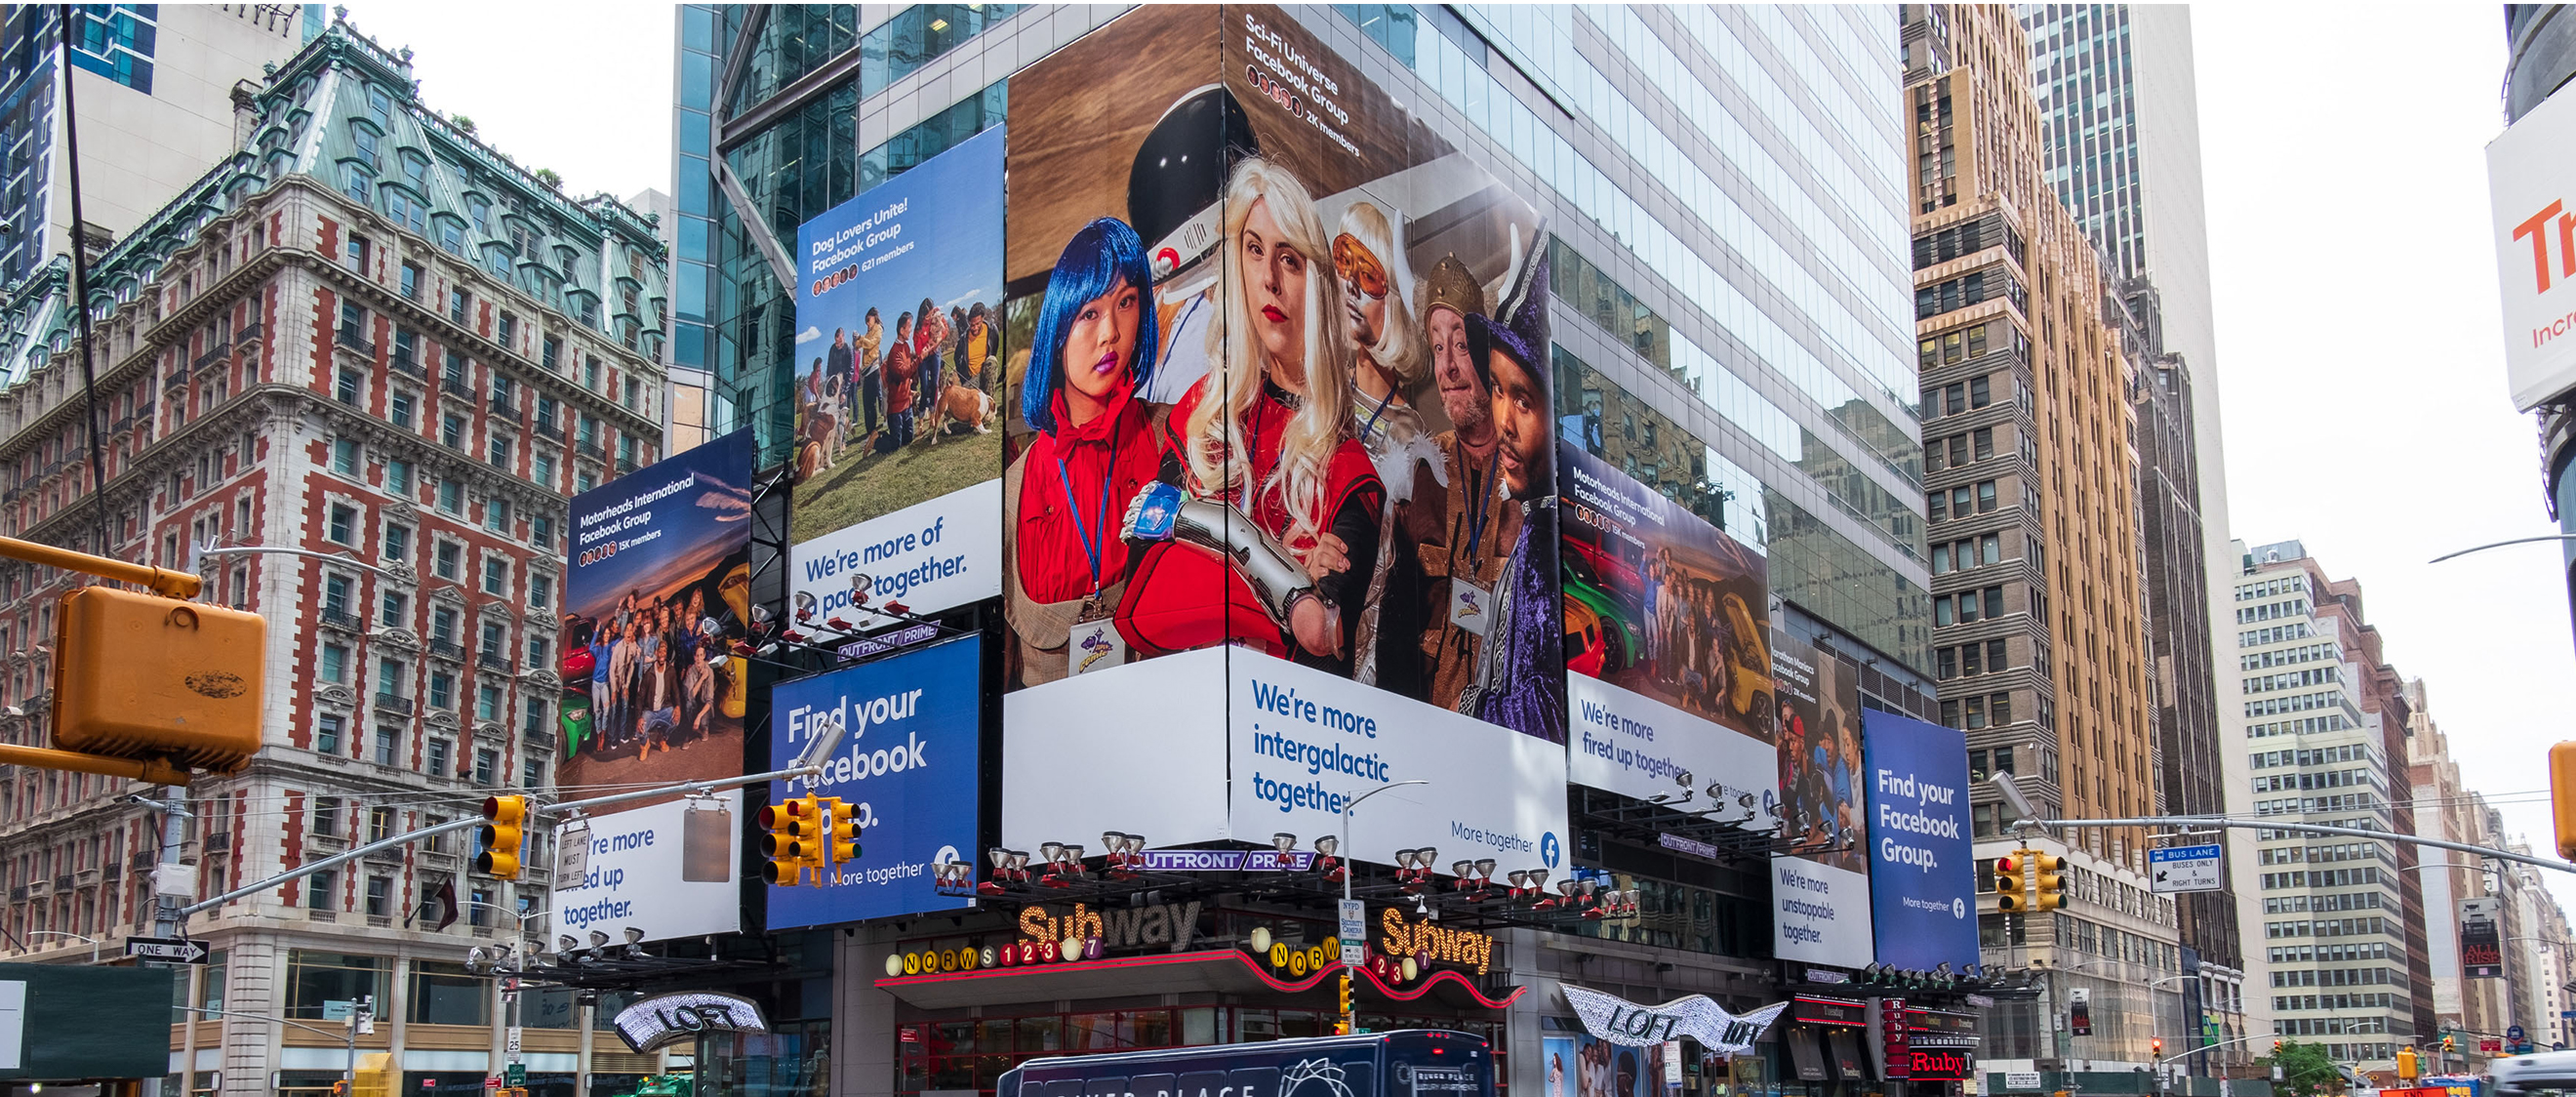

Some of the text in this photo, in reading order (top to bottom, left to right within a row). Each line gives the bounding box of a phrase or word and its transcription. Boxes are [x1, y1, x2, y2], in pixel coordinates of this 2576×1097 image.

[1246, 14, 1339, 96] Sci-Fi Universe
[1246, 36, 1349, 125] Facebook Group
[1307, 110, 1360, 157] 2K members
[812, 197, 908, 257] Dog Lovers Unite!
[812, 223, 902, 274] Facebook Group
[862, 240, 914, 272] 621 members
[580, 473, 695, 529] Motorheads International
[1573, 467, 1666, 527] Motorheads International
[1574, 484, 1636, 528] Facebook Group
[579, 509, 652, 546] Facebook Group
[619, 528, 662, 551] 15K members
[1611, 524, 1646, 549] 15K members
[806, 515, 944, 583] We're more of
[823, 588, 856, 619] pac
[874, 554, 967, 598] together.
[840, 626, 935, 658] OUTFRONT PRIME
[1772, 663, 1810, 688] acebook Group
[788, 688, 922, 743] Find your
[1252, 679, 1377, 739] We're more
[1581, 699, 1654, 742] We're more
[786, 731, 927, 792] Fcebook
[1254, 723, 1389, 782] intergalactic
[1583, 731, 1614, 761] fired
[1617, 748, 1632, 771] up
[1877, 769, 1954, 807] Find your
[1451, 820, 1482, 843] More
[1485, 827, 1534, 854] together
[1879, 803, 1959, 840] Facebook
[562, 835, 586, 849] LEFT LANE
[612, 830, 654, 852] more
[1663, 835, 1696, 852] OUTFRONT
[1880, 837, 1938, 874] Group.
[2168, 848, 2215, 859] BUS LANE
[564, 853, 580, 866] MUST
[571, 871, 584, 880] LEFT
[866, 861, 925, 885] together
[1138, 853, 1308, 869] UTFRONT PRE
[2172, 861, 2194, 870] BUSES
[603, 867, 624, 891] up
[1780, 868, 1829, 895] We're more
[564, 897, 632, 929] together.
[1343, 902, 1359, 911] NYPD
[1782, 895, 1834, 923] unstoppable
[1903, 896, 1920, 911] More
[1920, 898, 1950, 914] together
[1019, 901, 1201, 953] Subway
[1383, 908, 1493, 975] Subway
[1782, 920, 1823, 945] together.
[138, 945, 197, 956] ONE WAY
[907, 939, 1097, 970] N Q R W S 1 2 3 7
[2465, 953, 2501, 963] RISE
[655, 1004, 739, 1032] LOFT
[1607, 1005, 1683, 1040] LOFT
[1720, 1020, 1766, 1047] LOFT
[509, 1040, 519, 1051] 25
[1910, 1052, 1965, 1076] Ruby
